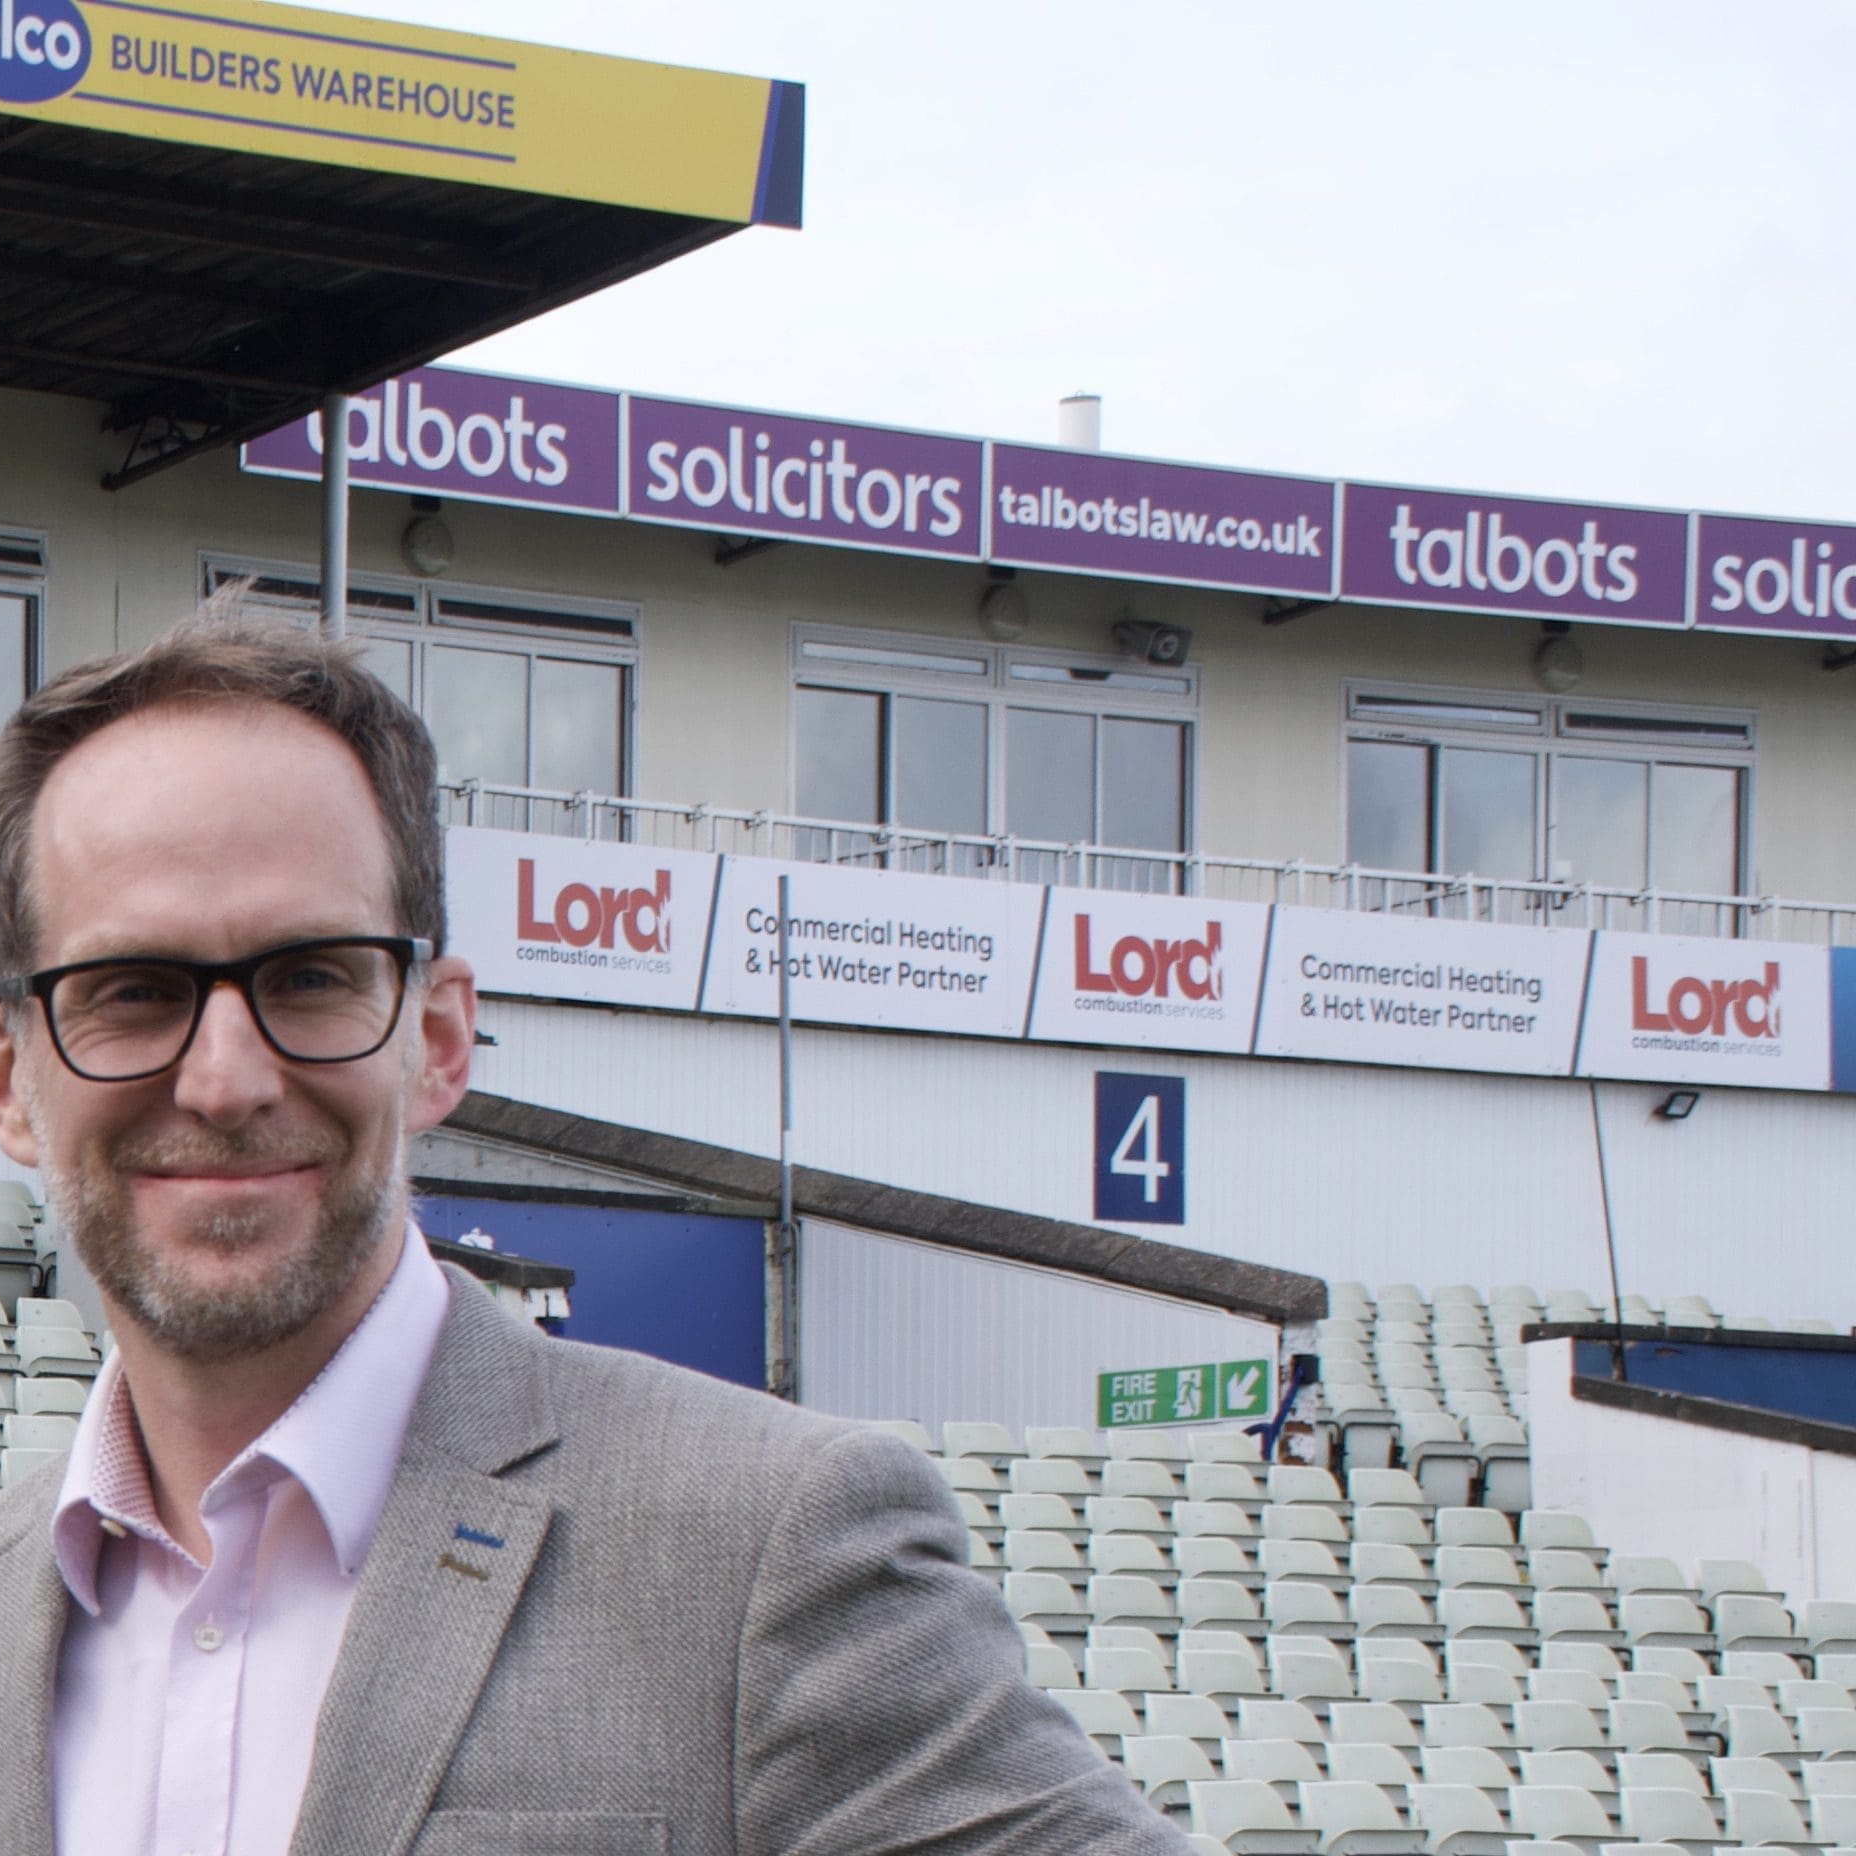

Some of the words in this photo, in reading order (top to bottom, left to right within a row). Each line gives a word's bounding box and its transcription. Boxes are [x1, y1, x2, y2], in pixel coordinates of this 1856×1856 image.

[111, 33, 281, 95] BUILDERS
[292, 62, 515, 129] WAREHOUSE
[646, 427, 962, 536] solicitors
[1000, 484, 1321, 558] talbotslaw.co.uk
[1390, 504, 1638, 602] talbots
[1711, 538, 1856, 620] solic
[517, 858, 671, 953] Lord
[746, 907, 891, 945] Commercial
[899, 922, 993, 962] Heating
[516, 946, 607, 968] combustion
[611, 955, 671, 974] services
[745, 948, 761, 974] &
[769, 950, 812, 979] Hot
[818, 954, 891, 985] Water
[898, 962, 987, 993] Partner
[1075, 913, 1222, 1000] Lord
[1301, 954, 1441, 989] Commercial
[1448, 966, 1543, 1003] Heating
[1074, 995, 1163, 1015] combustion
[1165, 1003, 1224, 1020] services
[1301, 992, 1316, 1016] &
[1323, 994, 1365, 1022] Hot
[1370, 998, 1441, 1027] Water
[1448, 1004, 1536, 1033] Partner
[1632, 956, 1779, 1038] Lord
[1632, 1036, 1720, 1053] combustion
[1111, 1094, 1170, 1202] 4
[1112, 1373, 1157, 1397] FIRE
[1112, 1399, 1156, 1423] EXIT
